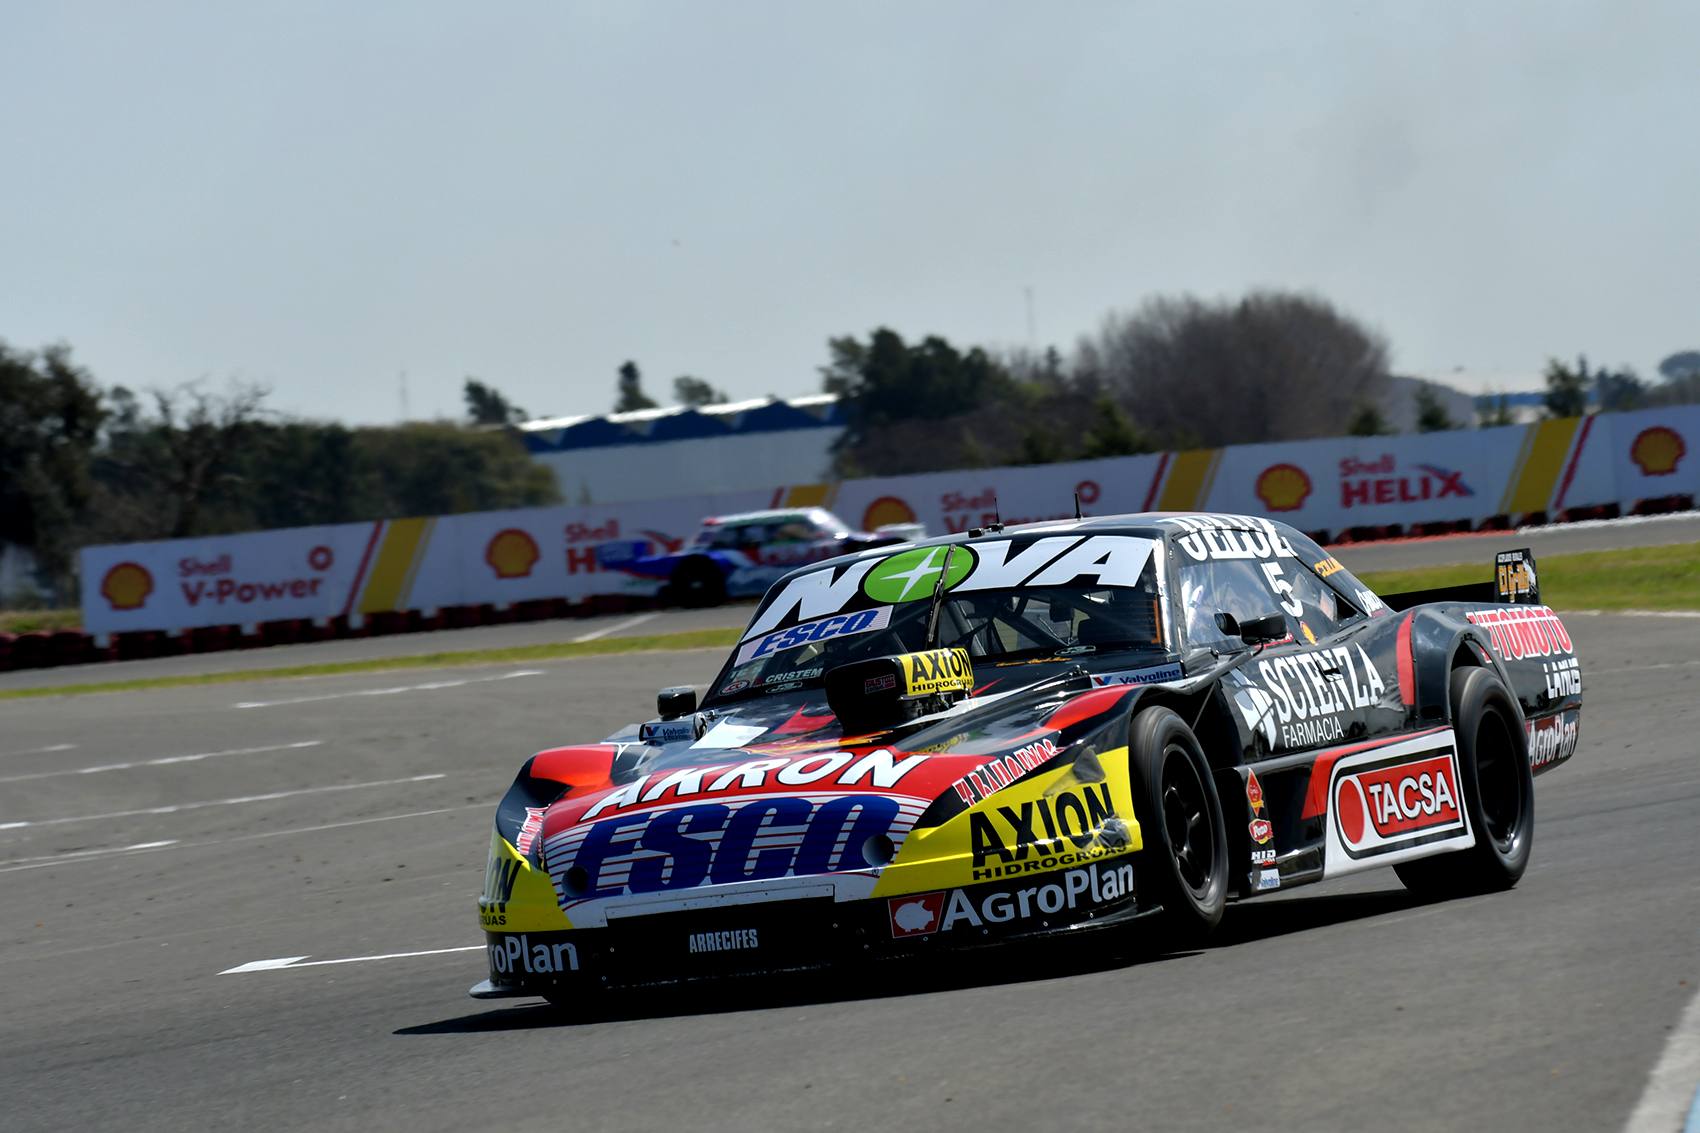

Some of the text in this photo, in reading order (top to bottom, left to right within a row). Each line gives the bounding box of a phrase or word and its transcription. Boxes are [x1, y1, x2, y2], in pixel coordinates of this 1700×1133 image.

[1339, 454, 1395, 477] Shell
[1340, 470, 1471, 508] HELIX
[565, 518, 620, 543] Shell
[1156, 515, 1299, 561] JELUZ
[178, 554, 231, 577] Shell
[181, 576, 320, 606] V-Power
[741, 535, 1157, 642] NOVA
[1260, 561, 1303, 617] 5
[753, 609, 879, 657] ESCO
[765, 667, 823, 683] CRISTEM
[912, 650, 972, 683] AXION
[1258, 642, 1386, 724] SCIENZA
[1282, 716, 1344, 748] FARMACIA
[580, 750, 930, 823] AKRON
[1368, 771, 1457, 825] TACSA
[969, 782, 1120, 869] AXION
[559, 794, 900, 906] ESCO
[689, 929, 759, 954] ARRECIFES
